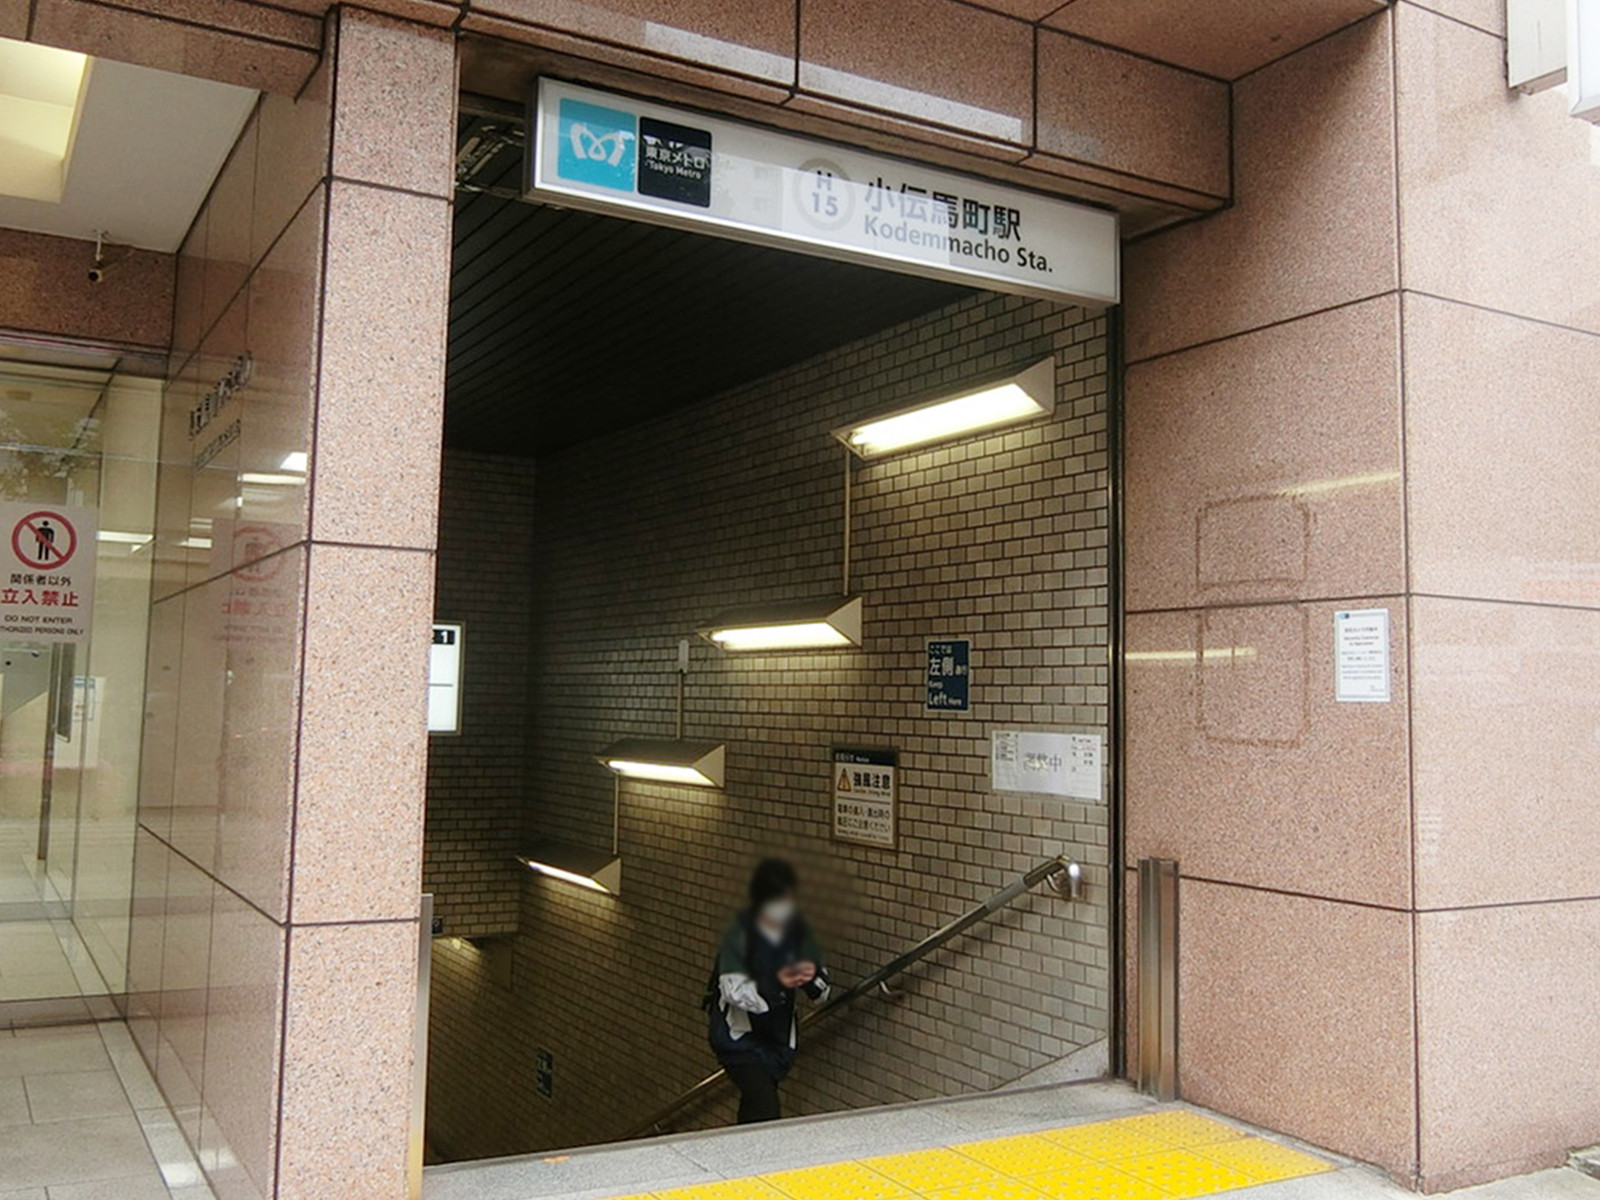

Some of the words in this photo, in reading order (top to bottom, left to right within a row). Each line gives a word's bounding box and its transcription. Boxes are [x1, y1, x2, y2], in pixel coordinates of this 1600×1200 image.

[645, 145, 706, 170] 東京メトロ
[649, 159, 674, 175] Tokyo
[676, 167, 702, 180] Metro
[816, 170, 832, 190] H
[811, 192, 839, 217] 15
[864, 177, 1021, 242] 小伝馬町駅
[864, 215, 1010, 263] Kodemmacho
[1016, 247, 1053, 273] Sta.
[10, 573, 71, 586] 関係者以外
[1, 588, 79, 607] 立入禁止
[4, 614, 19, 622] DO
[21, 615, 40, 623] NOT
[43, 616, 73, 624] ENTER
[929, 691, 948, 706] Left
[853, 771, 891, 790] 強風注意
